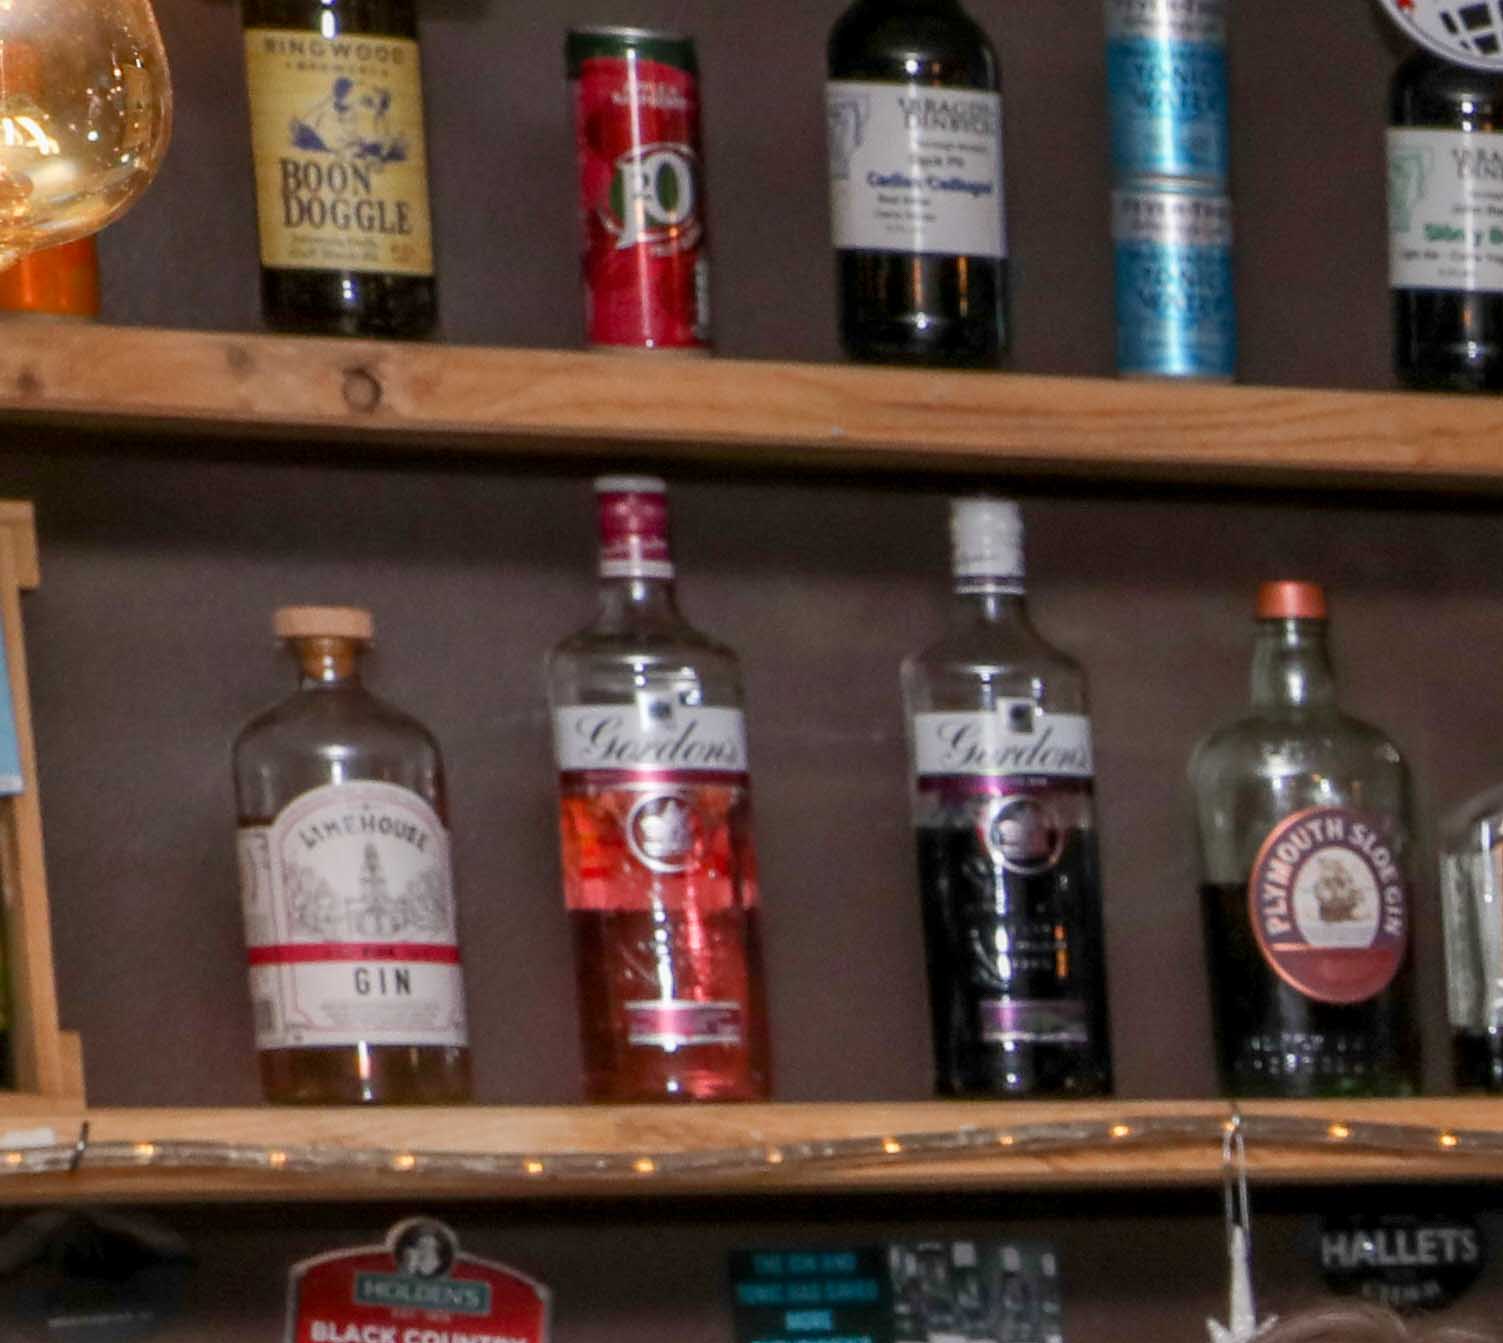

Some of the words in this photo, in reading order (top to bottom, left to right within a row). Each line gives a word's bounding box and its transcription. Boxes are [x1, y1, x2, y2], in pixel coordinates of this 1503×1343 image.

[280, 157, 372, 195] BOON
[283, 196, 411, 235] DOGGLE
[574, 712, 740, 764] Gordon's
[937, 718, 1093, 770] Gordon's
[299, 814, 434, 854] LIMEHOUSE
[1261, 817, 1344, 940] PLYMOUTH
[1348, 821, 1399, 886] SLOE
[1380, 886, 1403, 938] GIN
[353, 967, 413, 997] GIN
[1321, 1226, 1479, 1269] HALLETS
[363, 1281, 480, 1308] HOLDEN'S
